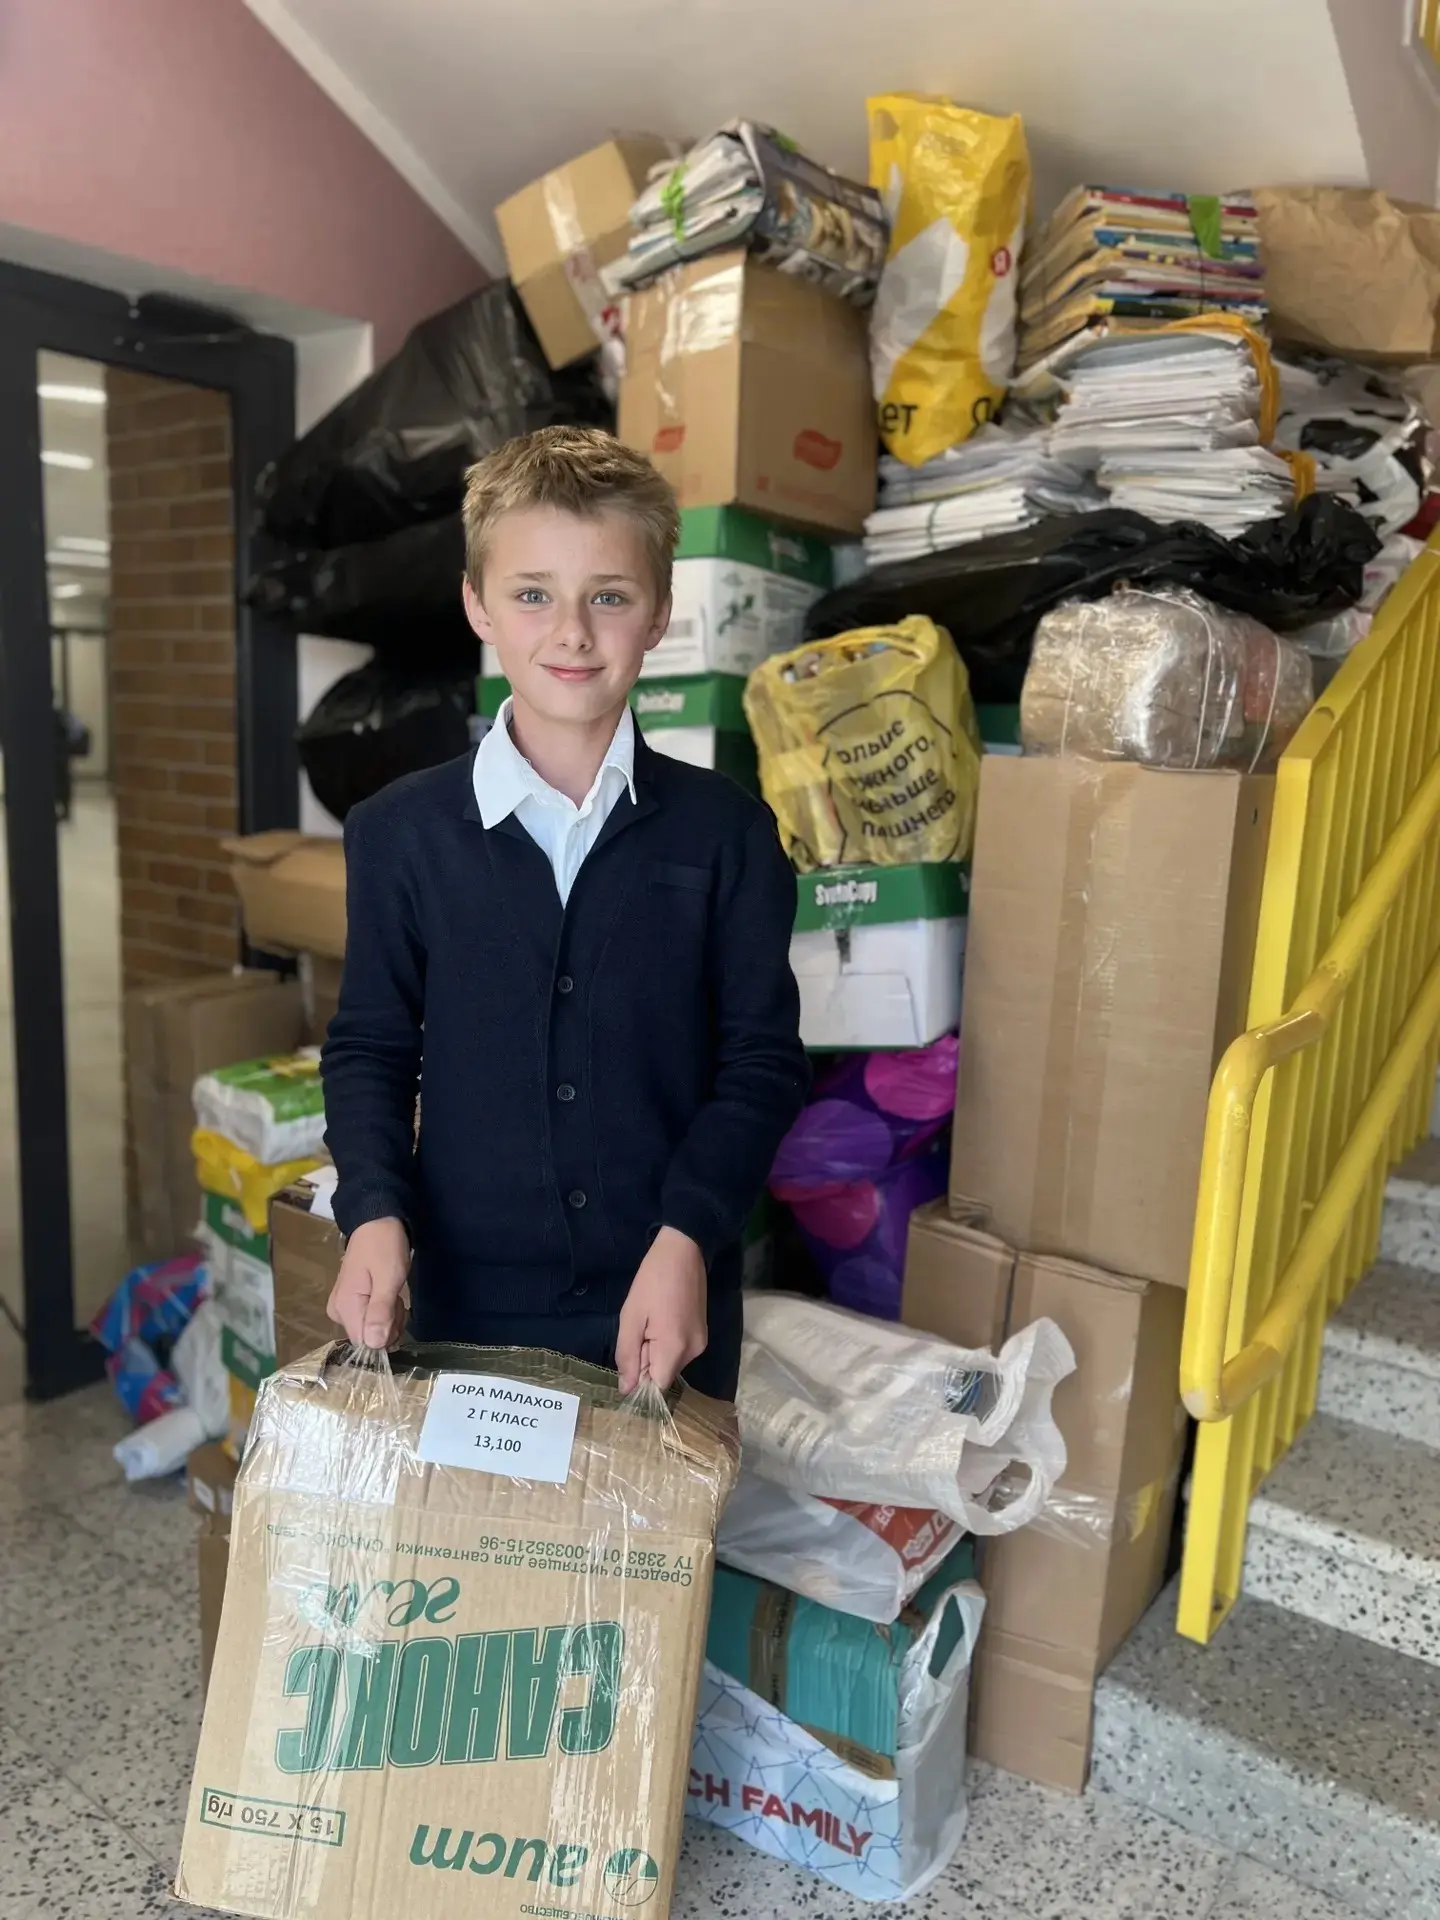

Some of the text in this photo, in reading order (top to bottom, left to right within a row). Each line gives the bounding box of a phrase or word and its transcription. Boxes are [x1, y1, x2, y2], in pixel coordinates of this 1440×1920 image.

[881, 403, 919, 435] ет
[451, 1383, 563, 1411] ЮРА МАЛАХОВ
[466, 1407, 540, 1429] 2 Г КЛАСС
[473, 1434, 522, 1453] 13,100
[396, 1541, 489, 1563] сантехники
[494, 1551, 525, 1567] для
[673, 1555, 693, 1570] ТУ
[528, 1556, 608, 1576] чистящее
[613, 1565, 692, 1587] Средство
[274, 1620, 625, 1774] САНОКС
[241, 1806, 281, 1828] 750
[687, 1769, 874, 1857] CH FAMILY
[309, 1816, 335, 1836] 15
[408, 1824, 589, 1888] аист
